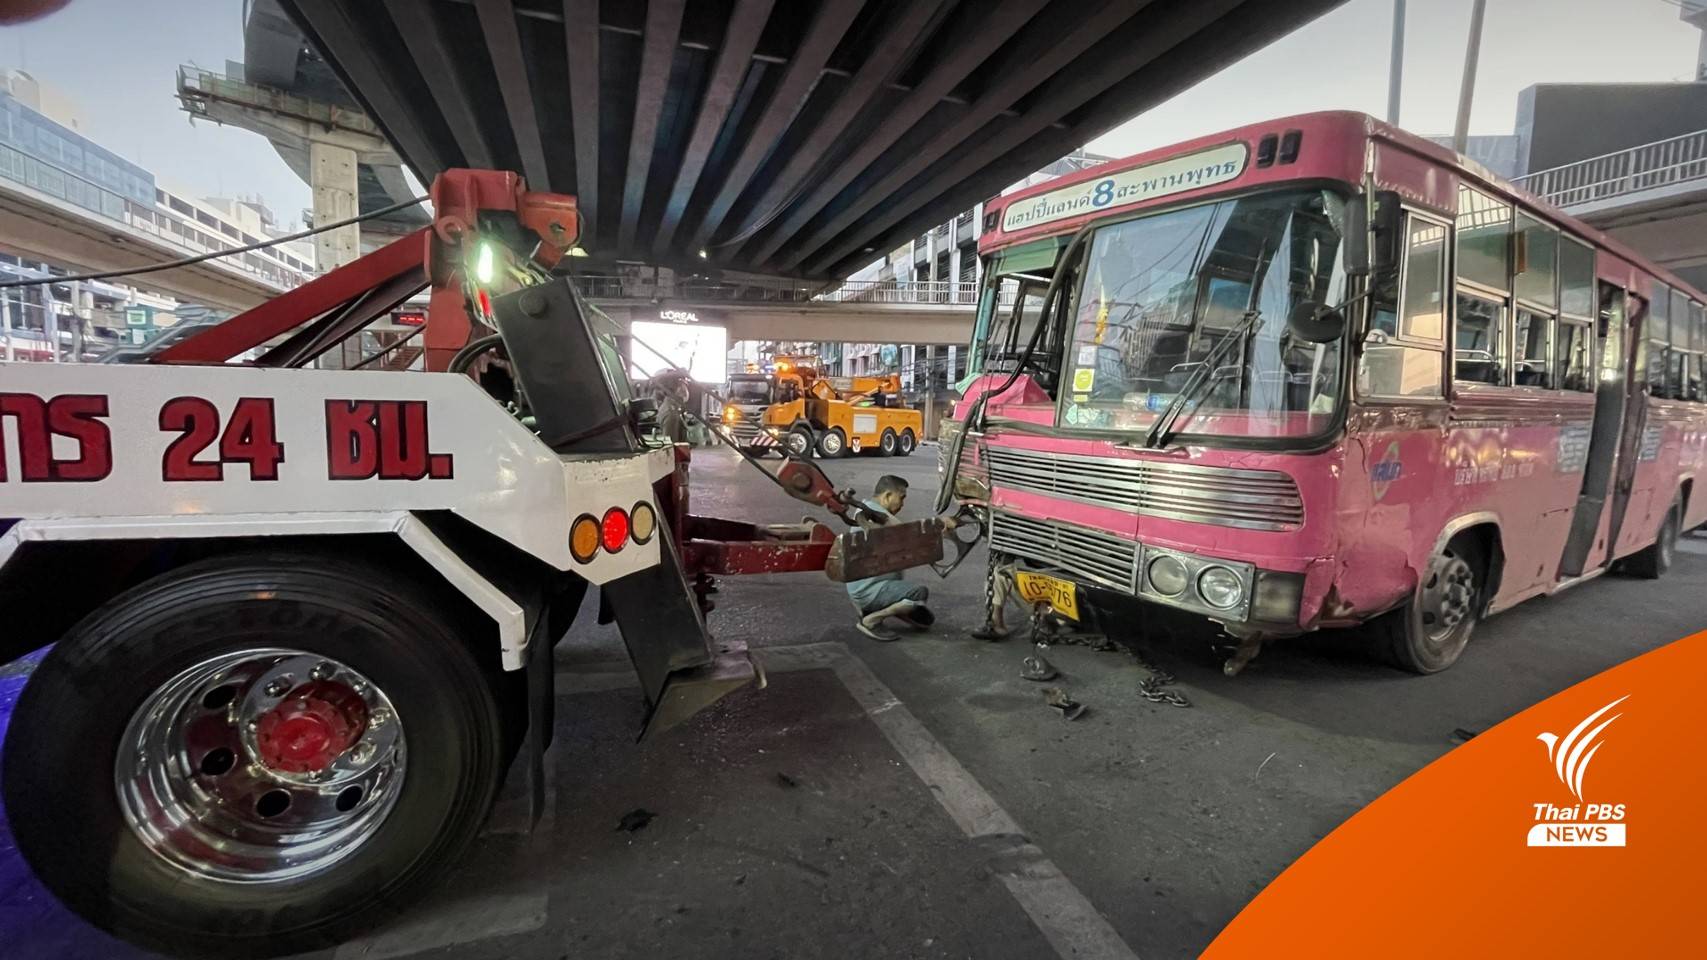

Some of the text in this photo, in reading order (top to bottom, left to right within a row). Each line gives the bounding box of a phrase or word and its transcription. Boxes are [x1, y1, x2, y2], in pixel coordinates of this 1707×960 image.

[1093, 179, 1116, 207] 8
[1117, 160, 1238, 198] สะพานพุทธ
[158, 396, 285, 481] 24
[324, 398, 454, 481] ชม.
